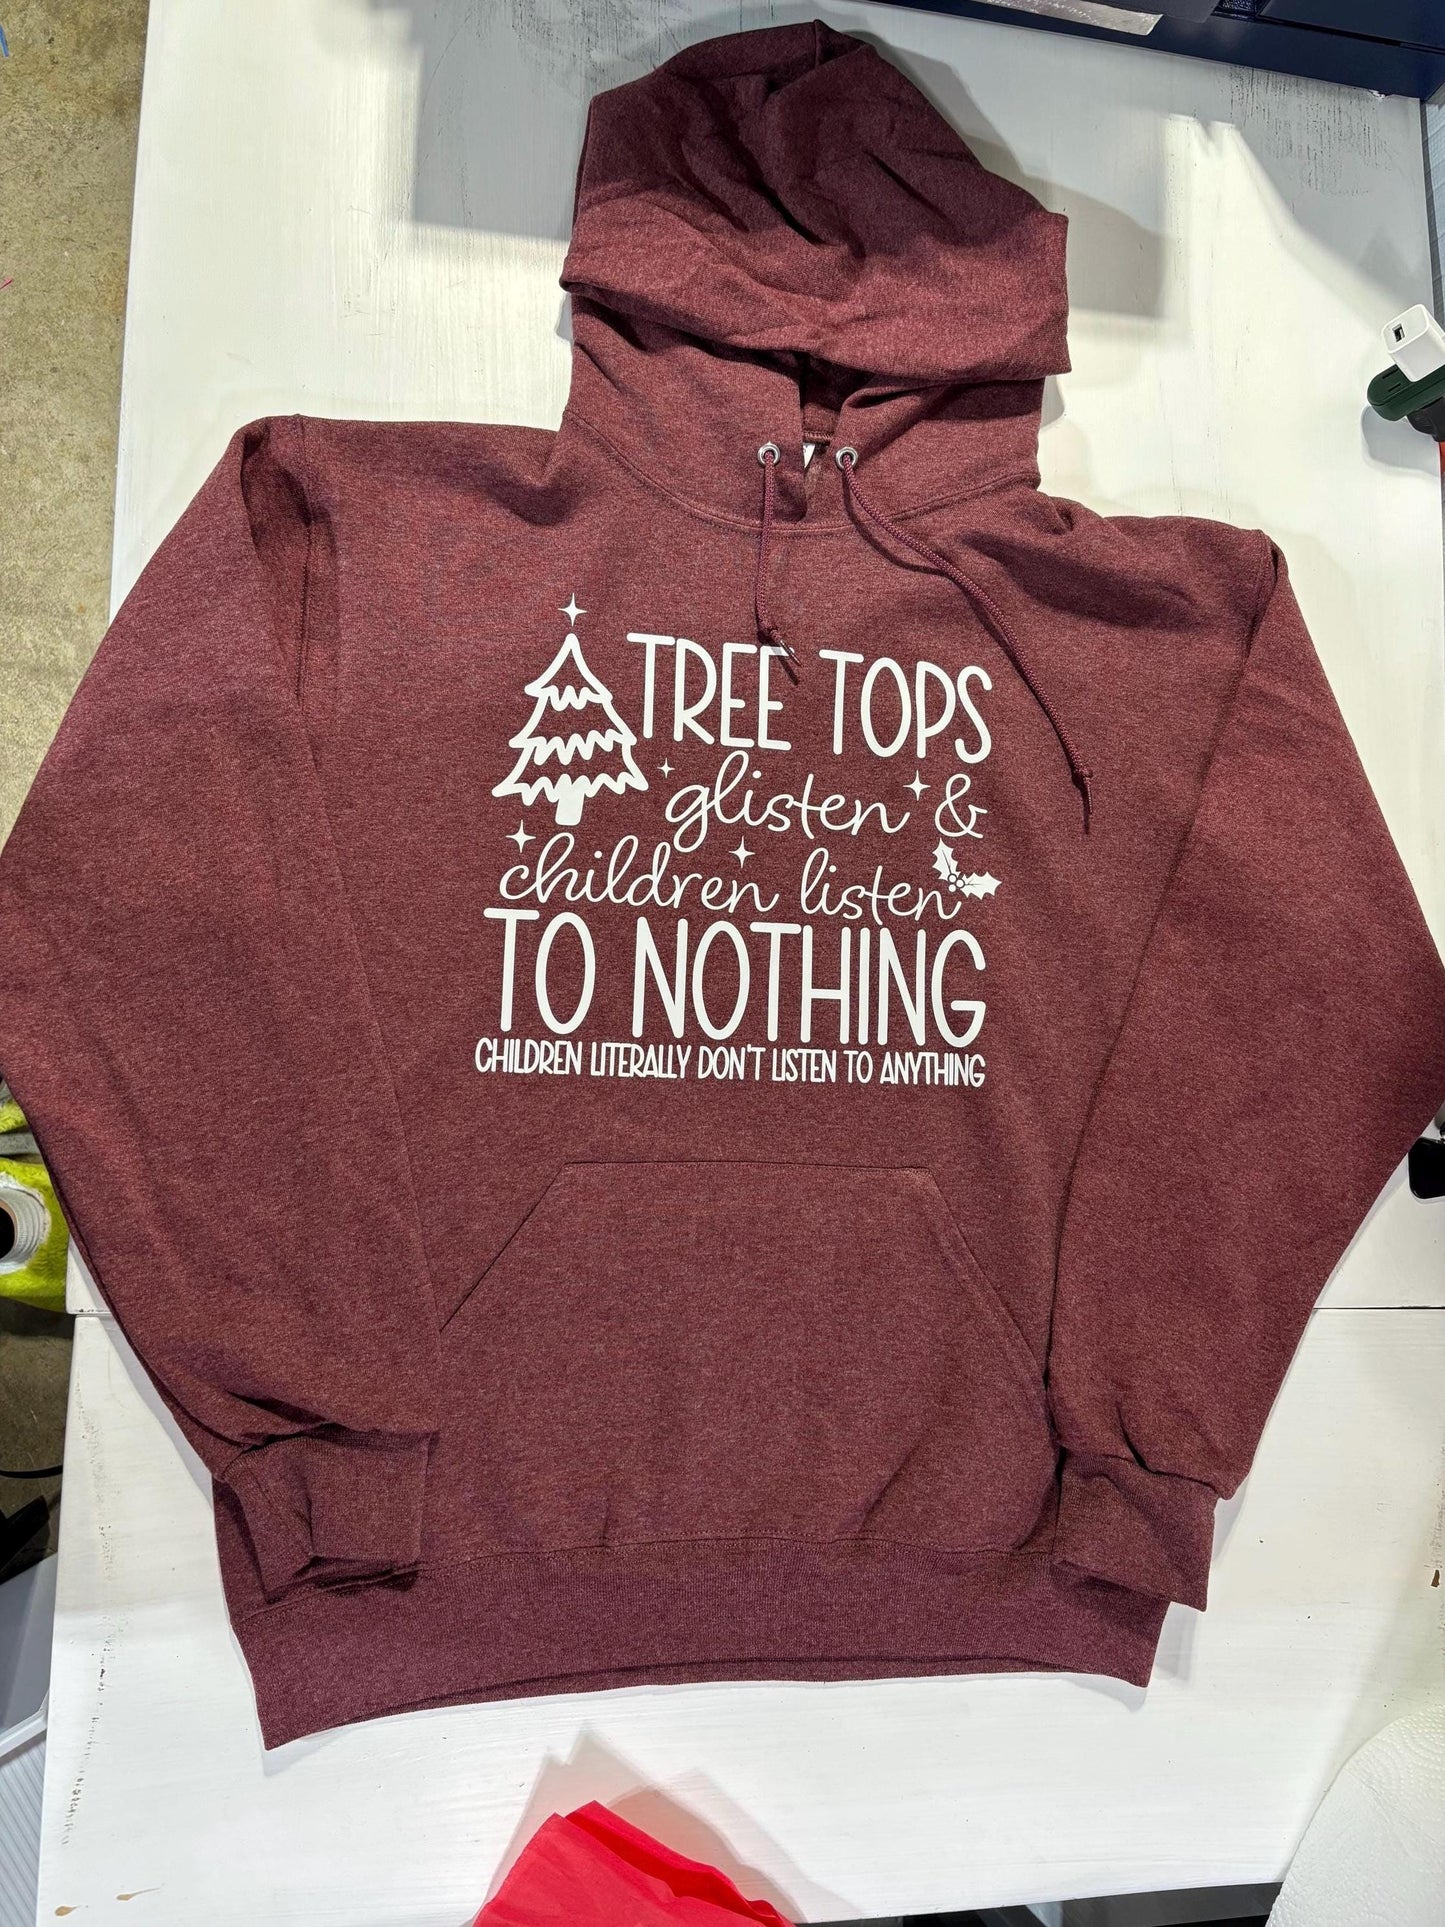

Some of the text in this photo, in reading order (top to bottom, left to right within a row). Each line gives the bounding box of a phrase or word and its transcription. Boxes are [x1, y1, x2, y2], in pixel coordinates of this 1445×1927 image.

[626, 632, 993, 764] TREE TOPS
[664, 749, 988, 853] glisten &
[499, 832, 962, 926] children listen
[483, 907, 987, 1048] TO NOTHING
[474, 1037, 986, 1088] CHILDREN LITERALLY DON'T LISTEN TO ANYTHING
